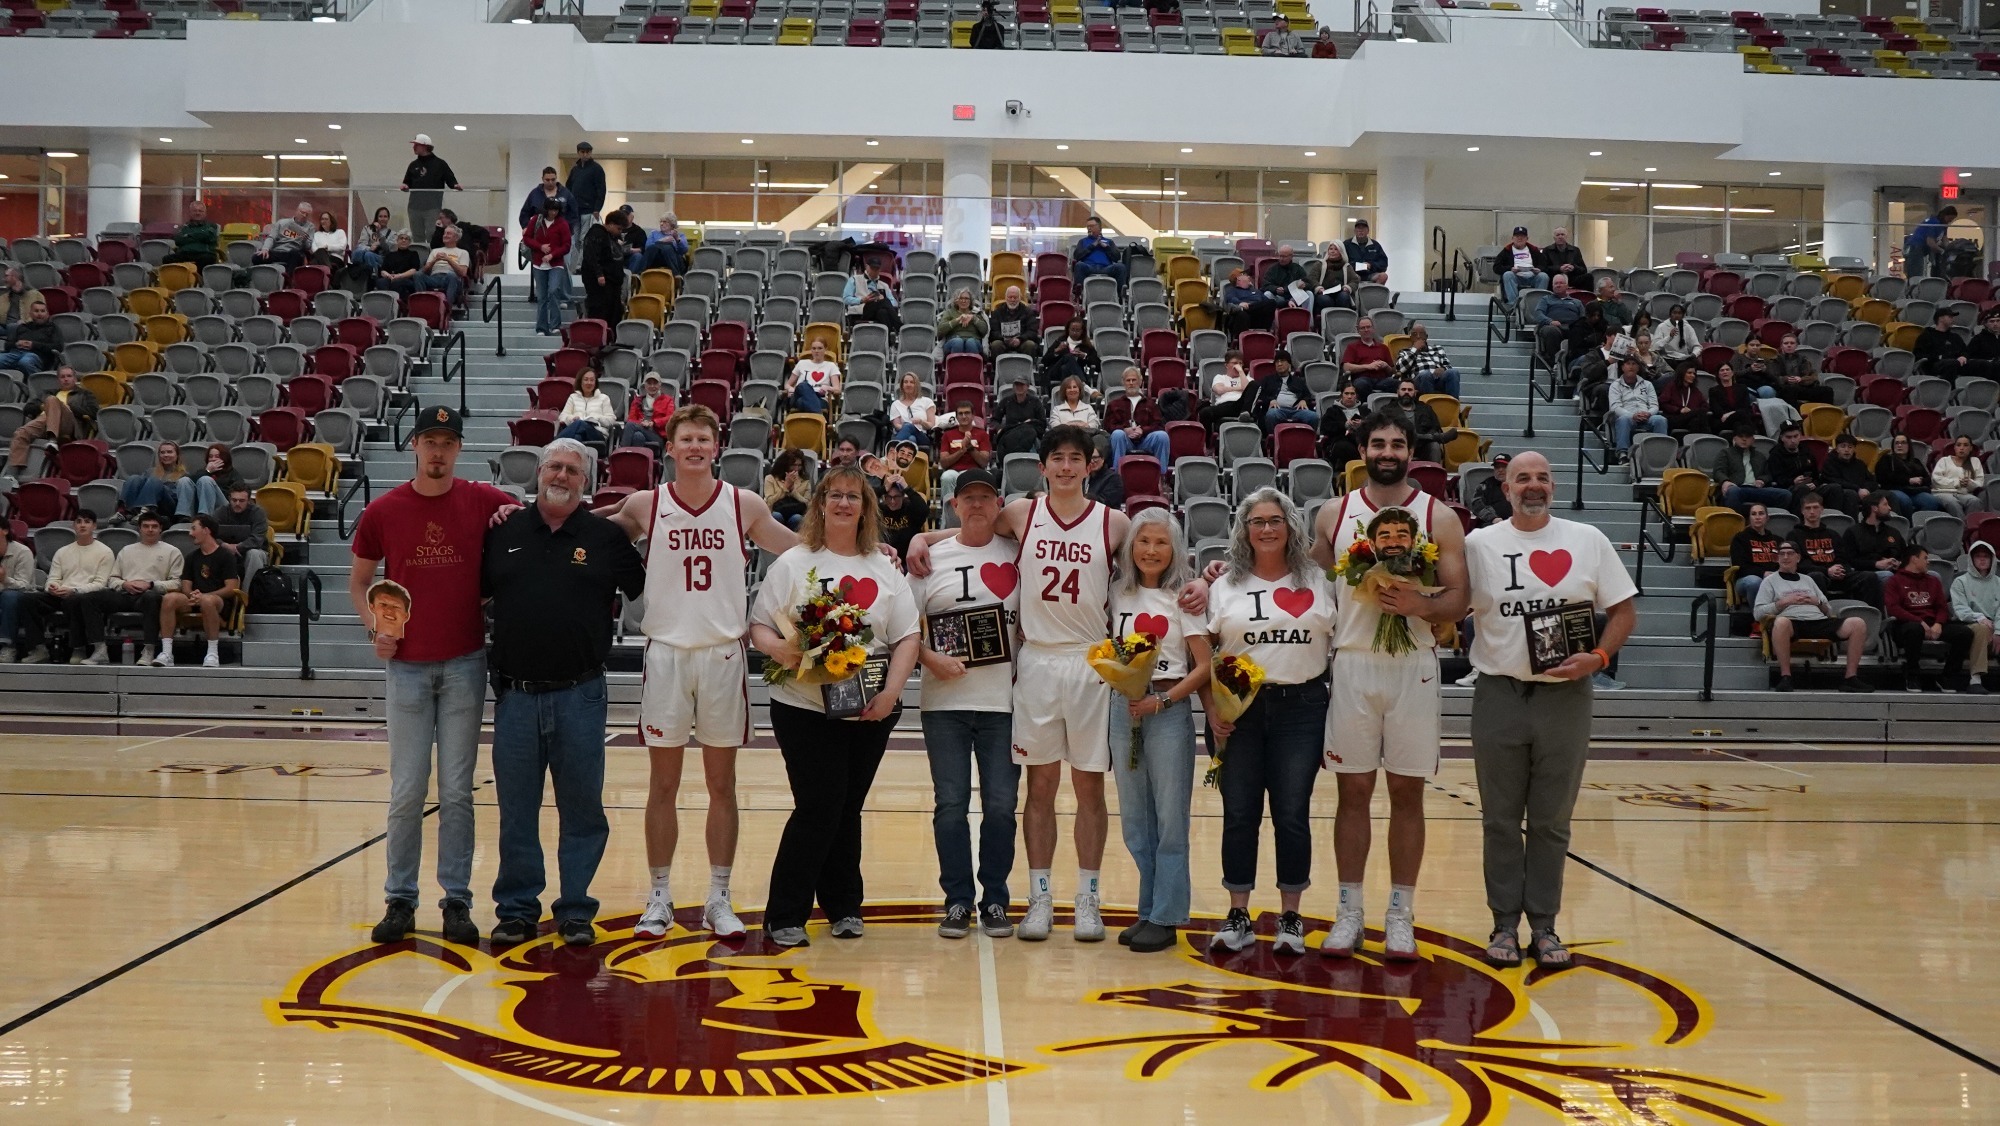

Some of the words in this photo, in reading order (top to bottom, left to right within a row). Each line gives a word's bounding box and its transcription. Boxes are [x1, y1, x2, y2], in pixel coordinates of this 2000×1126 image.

[416, 545, 454, 557] STAGS
[668, 528, 725, 551] STAGS
[1035, 539, 1092, 564] STAGS
[405, 555, 465, 567] BASKETBALL
[683, 555, 712, 592] 13
[1502, 552, 1525, 592] I
[954, 565, 977, 603] I
[1041, 565, 1080, 605] 24
[1246, 589, 1270, 622] I
[1243, 628, 1313, 646] CAHAL
